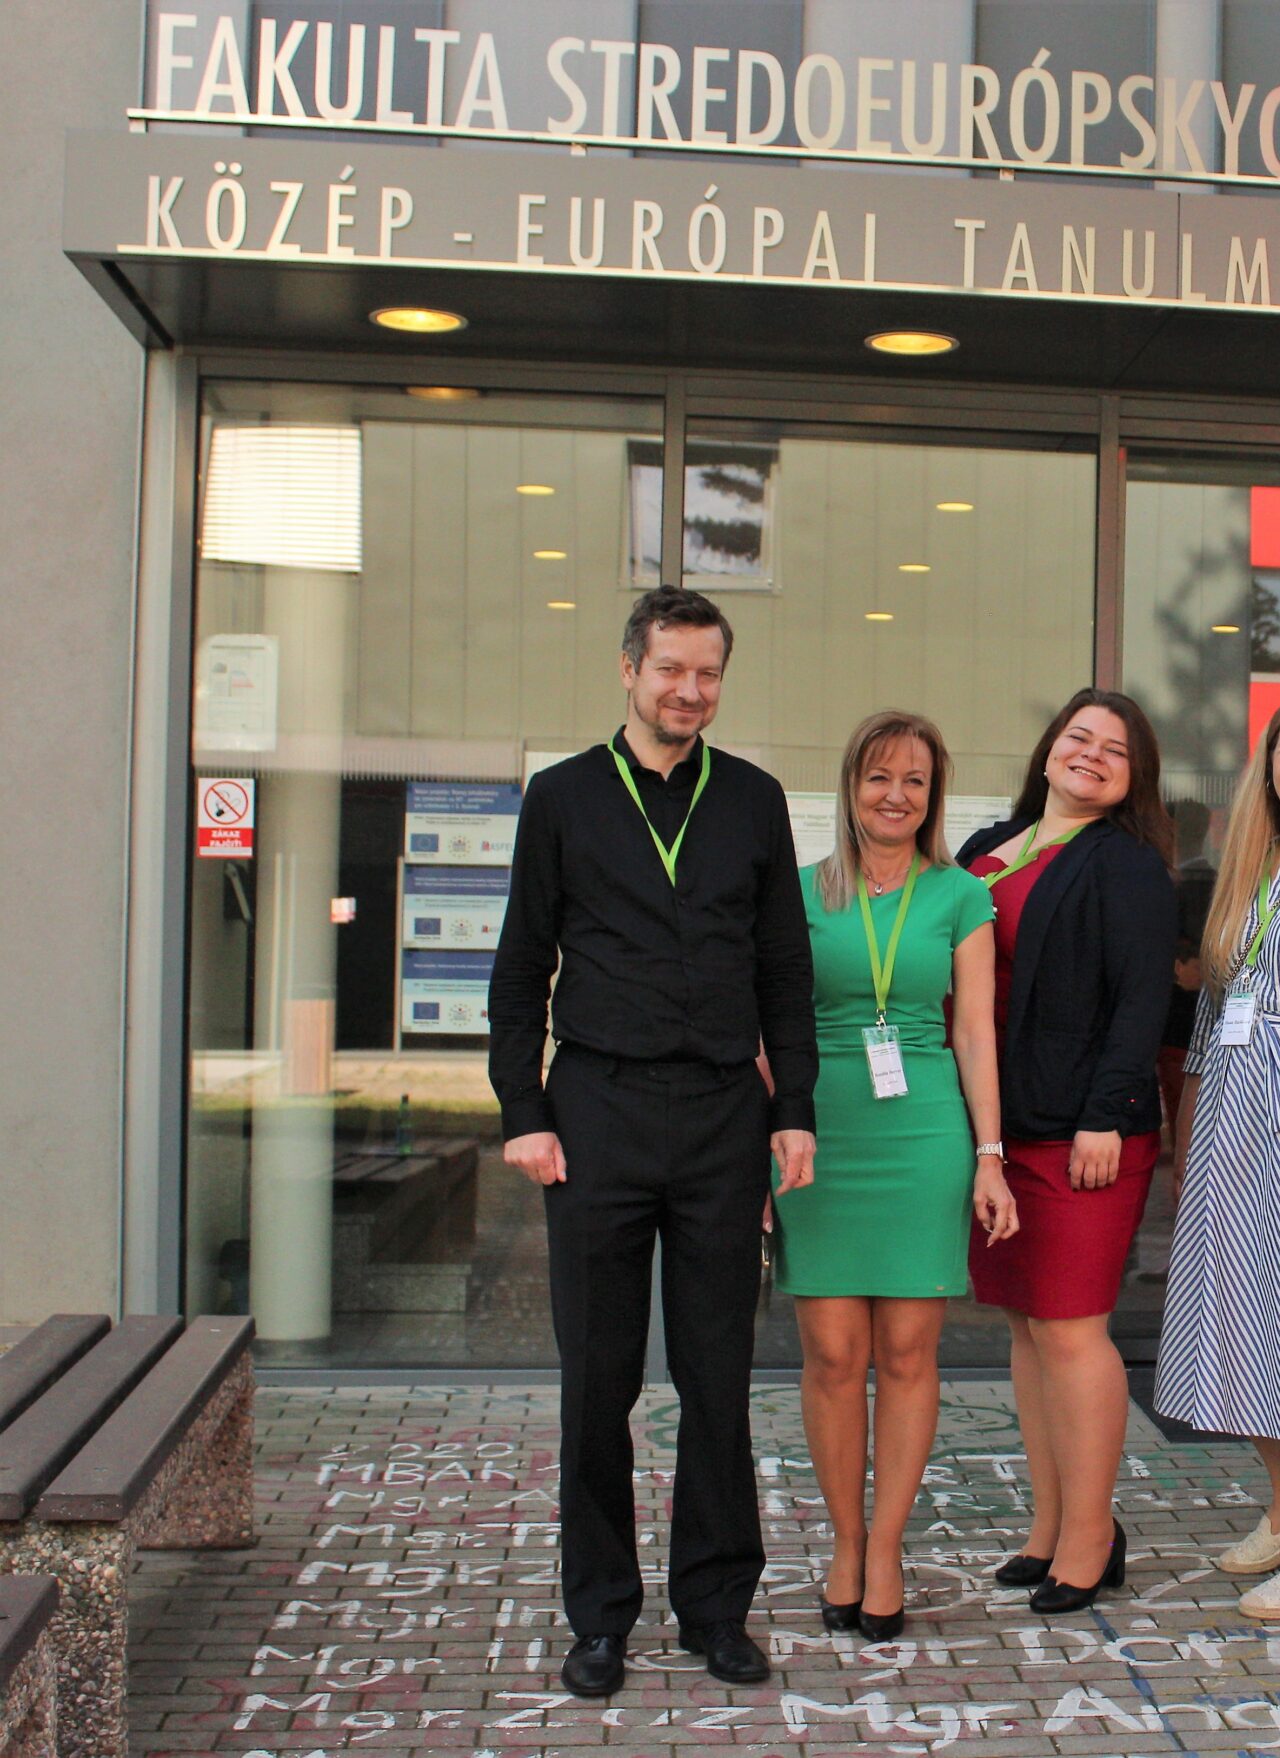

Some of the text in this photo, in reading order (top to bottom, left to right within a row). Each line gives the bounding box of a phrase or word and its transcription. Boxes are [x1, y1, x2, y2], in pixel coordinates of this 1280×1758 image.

[157, 14, 509, 132] FAKULTA
[147, 162, 414, 259] KÖZÉP
[518, 185, 876, 283] EURÓPAI
